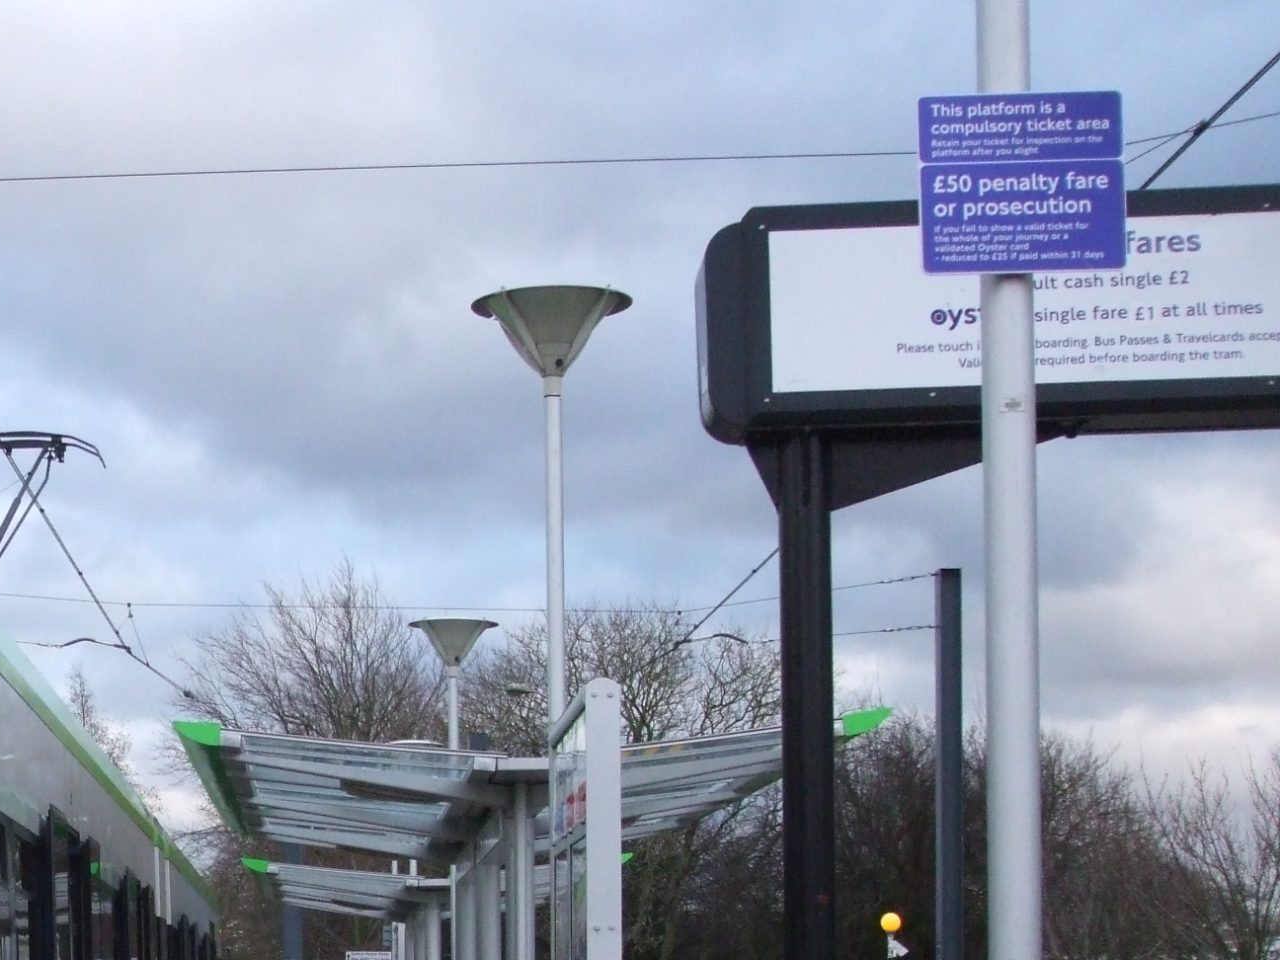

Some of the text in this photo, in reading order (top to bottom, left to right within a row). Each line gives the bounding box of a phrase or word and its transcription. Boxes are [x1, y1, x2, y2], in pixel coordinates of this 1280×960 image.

[930, 100, 1066, 119] This platform is a
[931, 118, 1110, 137] compulsory ticket area
[930, 139, 960, 147] Retain
[962, 140, 981, 148] your
[984, 138, 1009, 146] ticket
[1011, 137, 1024, 145] for
[1088, 135, 1104, 143] the
[932, 148, 970, 158] platform
[972, 148, 994, 156] after
[996, 148, 1013, 157] you
[933, 171, 1109, 197] £50 penalty fare
[933, 196, 1092, 221] or prosecution
[934, 234, 950, 243] the
[951, 234, 980, 242] whole
[981, 233, 991, 241] of
[994, 234, 1013, 243] your
[1015, 233, 1049, 243] journey
[1051, 232, 1062, 240] or
[943, 226, 960, 235] you
[962, 225, 976, 233] fail
[978, 224, 989, 232] to
[990, 224, 1015, 232] show
[1024, 222, 1045, 231] valid
[1047, 221, 1073, 231] ticket
[1075, 221, 1089, 230] for
[977, 243, 1008, 253] Oyster
[1126, 231, 1202, 254] fares
[941, 253, 978, 262] reduced
[980, 253, 990, 261] to
[1019, 251, 1038, 262] paid
[1040, 250, 1069, 260] within
[1033, 270, 1190, 290] ult cash single £2
[1034, 306, 1087, 325] single
[1093, 306, 1128, 321] fare
[1135, 306, 1155, 321] £1
[1162, 304, 1180, 318] at
[1186, 302, 1208, 317] all
[1213, 301, 1264, 316] times
[897, 342, 935, 353] Please
[938, 341, 974, 353] touch
[1094, 336, 1116, 347] Bus
[1120, 335, 1160, 347] Passes
[1163, 333, 1172, 344] &
[1176, 331, 1245, 344] Travelcards
[1035, 354, 1085, 367] required
[1089, 352, 1129, 364] before
[1132, 350, 1186, 363] boarding
[1189, 350, 1210, 360] the
